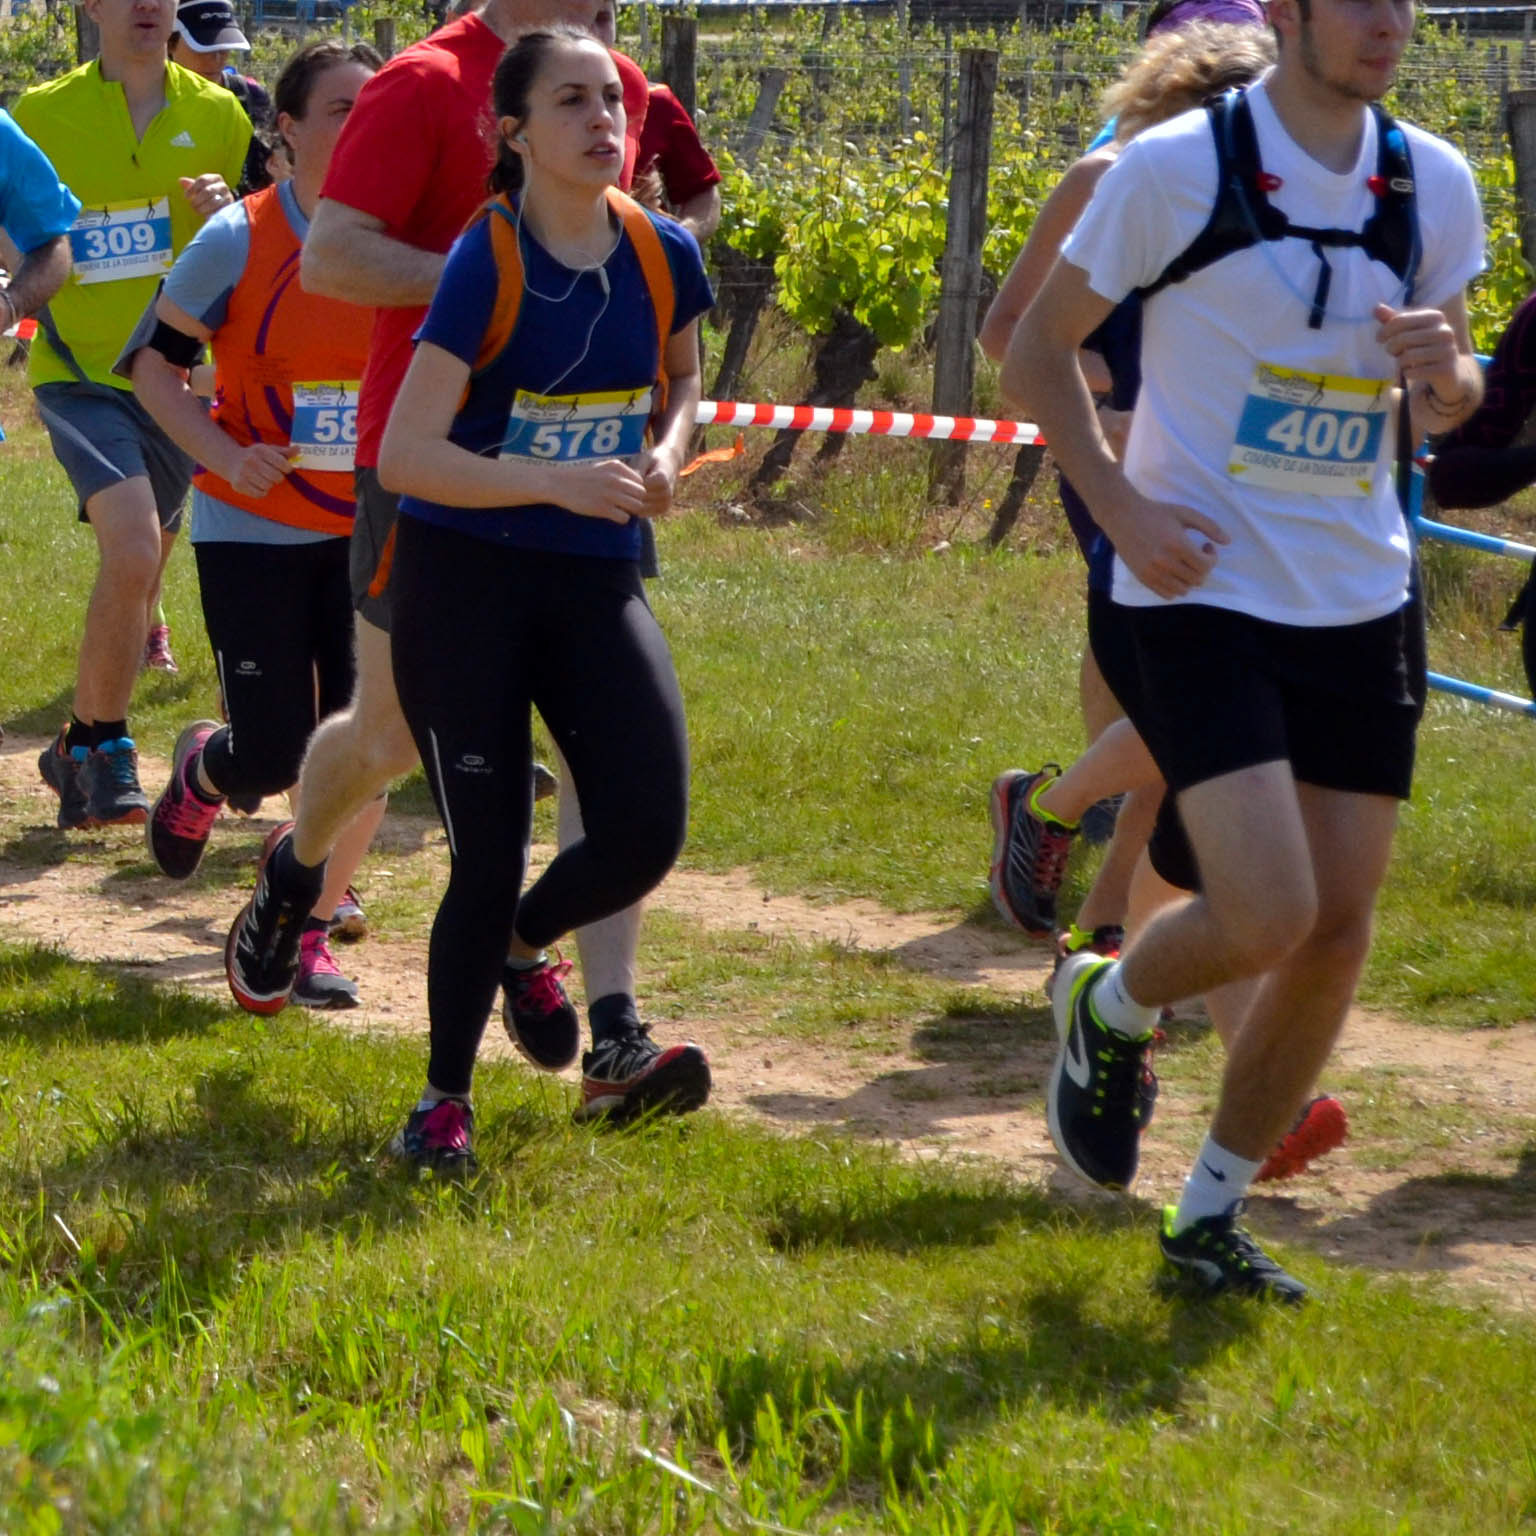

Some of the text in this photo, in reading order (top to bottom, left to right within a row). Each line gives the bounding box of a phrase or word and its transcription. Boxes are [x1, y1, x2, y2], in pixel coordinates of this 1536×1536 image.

[85, 223, 156, 259] 309
[312, 408, 358, 443] 58
[530, 418, 624, 459] 578
[1266, 409, 1370, 460] 400
